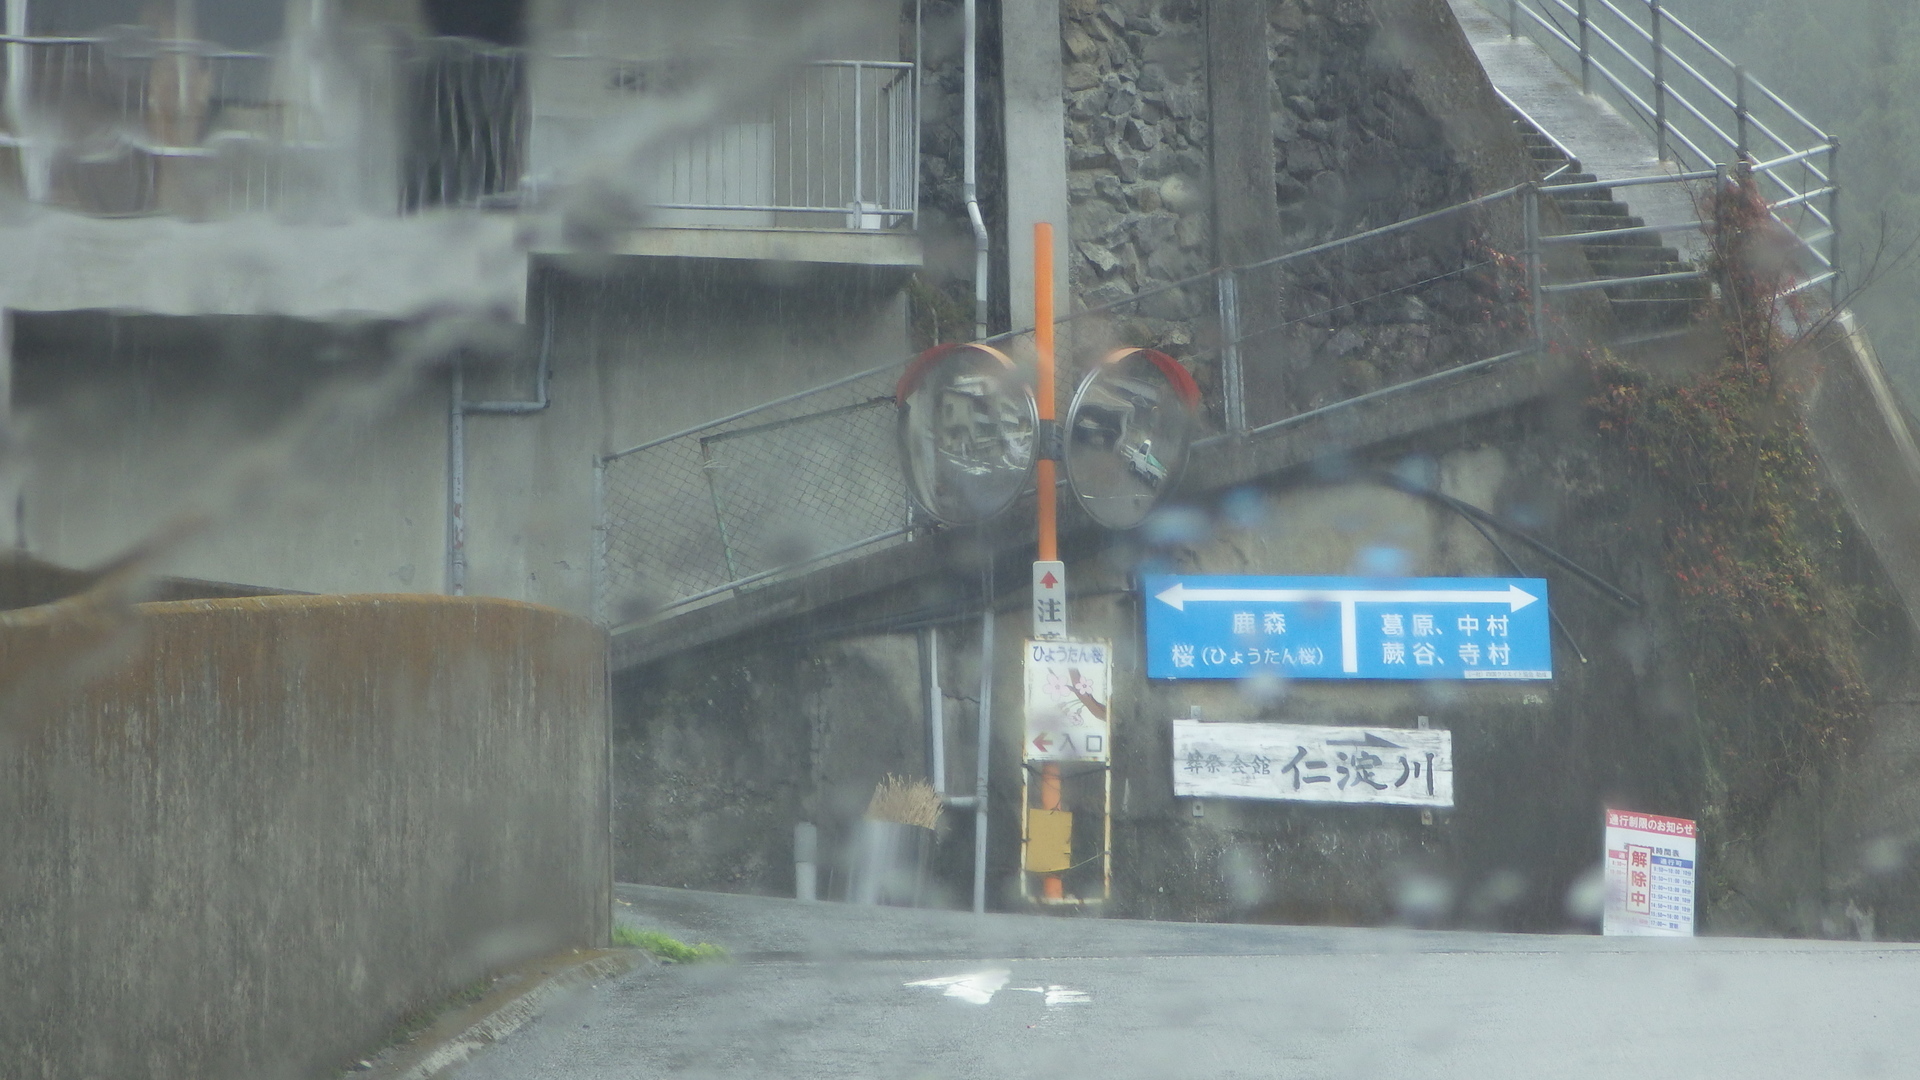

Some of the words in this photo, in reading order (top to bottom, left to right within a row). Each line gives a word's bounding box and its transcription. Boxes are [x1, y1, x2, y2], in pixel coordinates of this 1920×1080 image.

[1233, 611, 1287, 635] 鹿森
[1381, 613, 1509, 637] 葛原、中村
[1032, 645, 1105, 664] ひょうたん桜
[1382, 642, 1511, 666] 蕨谷、寺村
[1059, 732, 1103, 753] 入口
[1184, 752, 1272, 776] 葬祭会館
[1281, 745, 1435, 796] 仁淀川
[1608, 813, 1694, 836] 通行制限のお知らせ
[1630, 850, 1648, 907] 解除中
